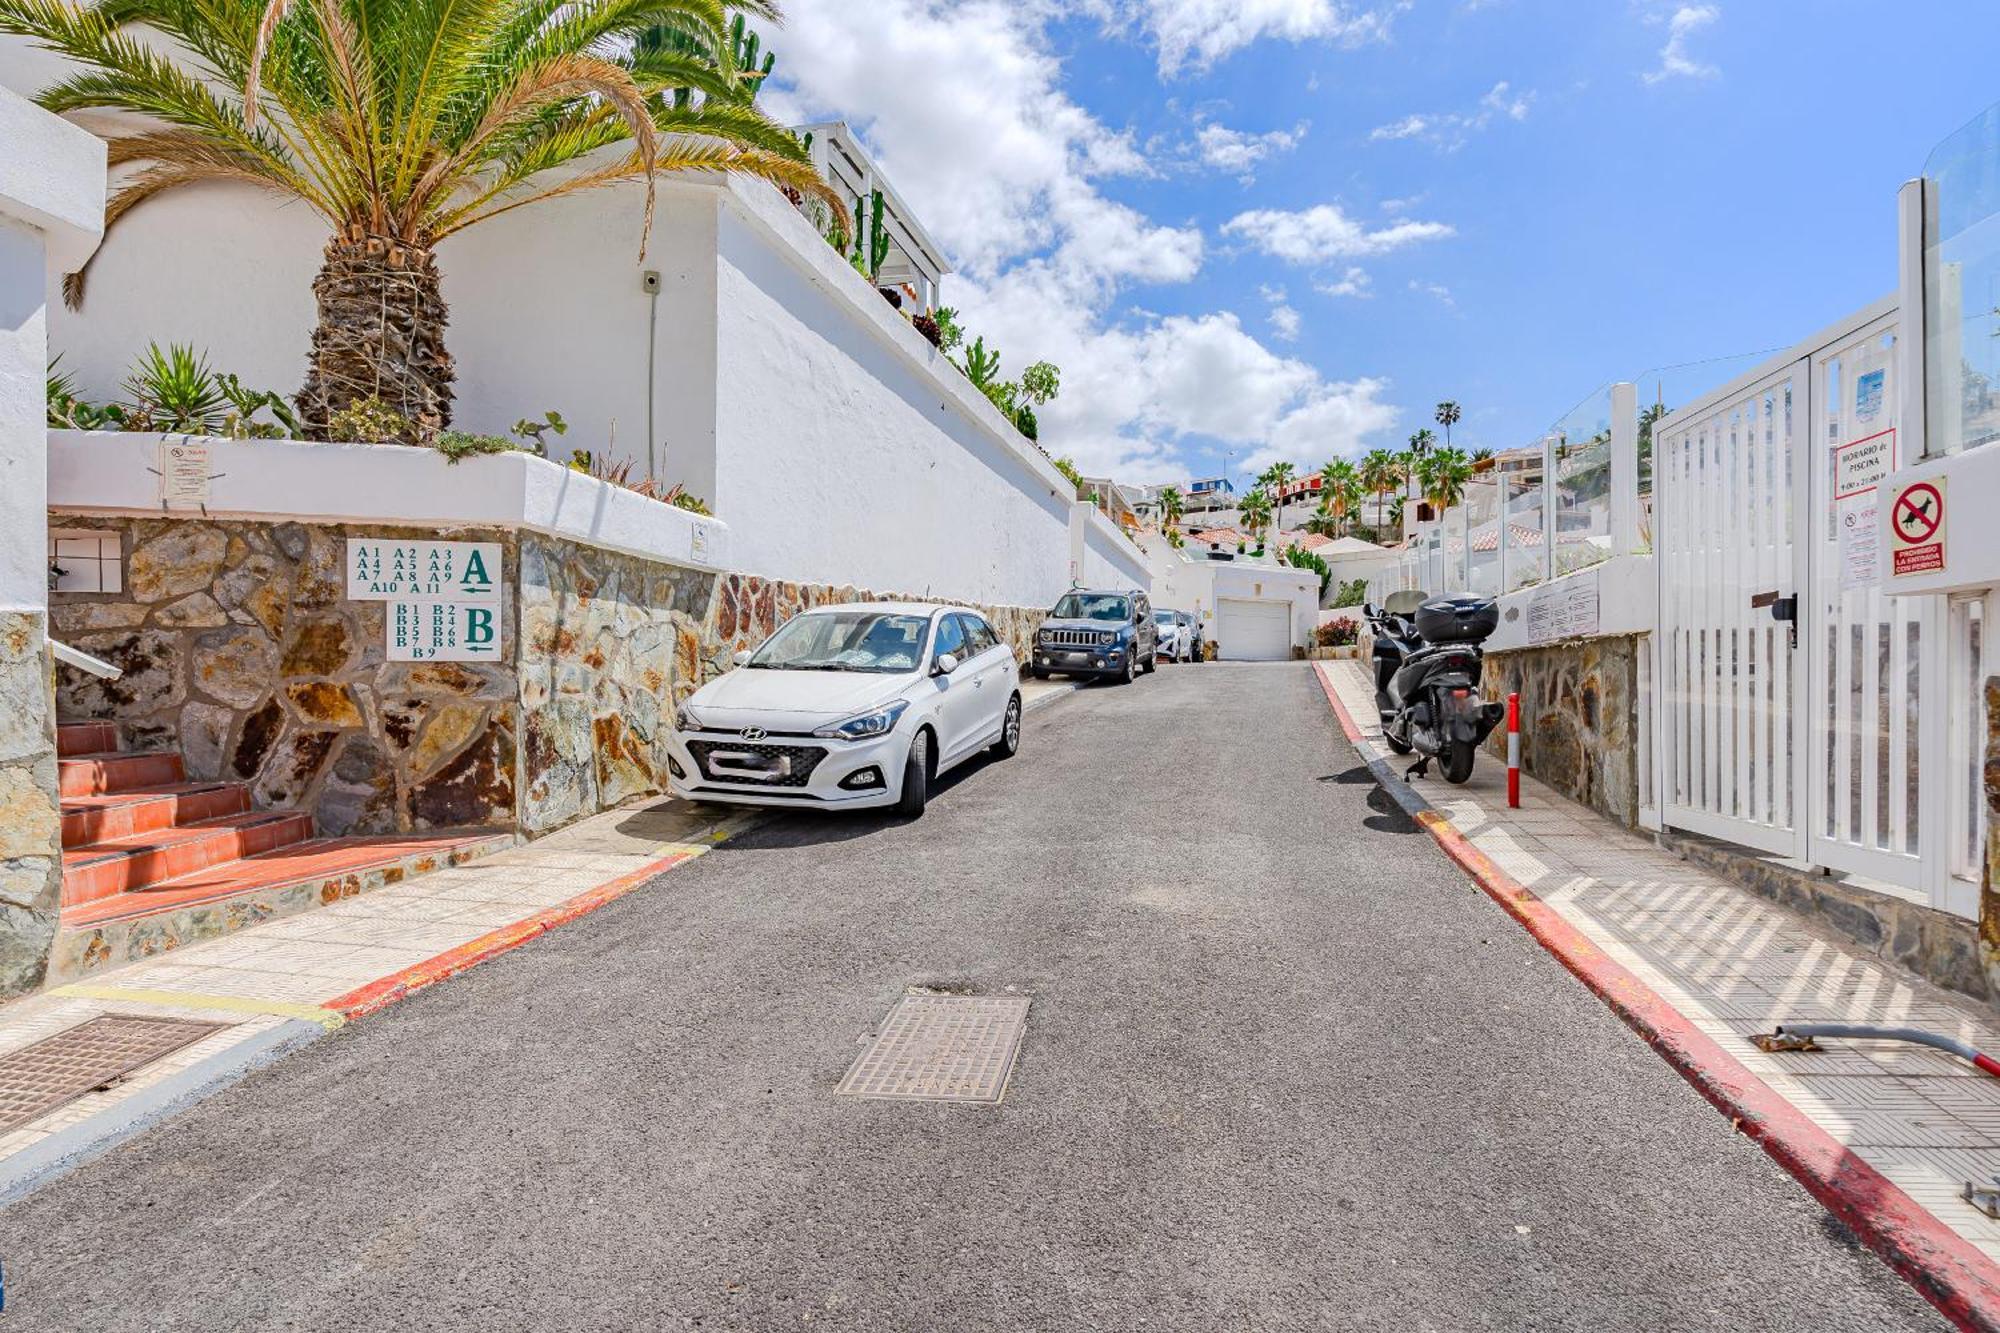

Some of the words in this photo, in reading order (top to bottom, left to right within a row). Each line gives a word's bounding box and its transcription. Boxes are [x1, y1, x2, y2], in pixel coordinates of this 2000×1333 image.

[358, 546, 368, 557] A
[374, 547, 379, 557] 1
[394, 548, 404, 558] A
[409, 548, 416, 559] 2
[429, 549, 439, 559] A
[357, 558, 368, 569] A
[373, 559, 380, 569] 4
[394, 560, 404, 569] A
[409, 560, 416, 570] 5
[429, 561, 440, 571] A
[445, 561, 452, 571] 6
[459, 550, 493, 584] A
[357, 570, 368, 580] A
[373, 570, 380, 580] 7
[394, 571, 404, 581] A
[409, 571, 416, 581] 8
[444, 572, 452, 583] 9
[397, 604, 407, 615] B
[413, 605, 418, 615] 1
[433, 605, 443, 615] B
[448, 605, 455, 615] 2
[397, 616, 407, 625] B
[412, 616, 419, 625] 3
[433, 616, 443, 626] B
[464, 608, 494, 643] B
[397, 626, 407, 636] B
[412, 626, 419, 636] 5
[433, 626, 443, 636] B
[448, 626, 455, 637] 6
[397, 637, 407, 647] B
[413, 637, 419, 647] 7
[433, 637, 443, 647] B
[448, 637, 455, 647] 8
[413, 648, 423, 658] B
[428, 648, 435, 658] 9
